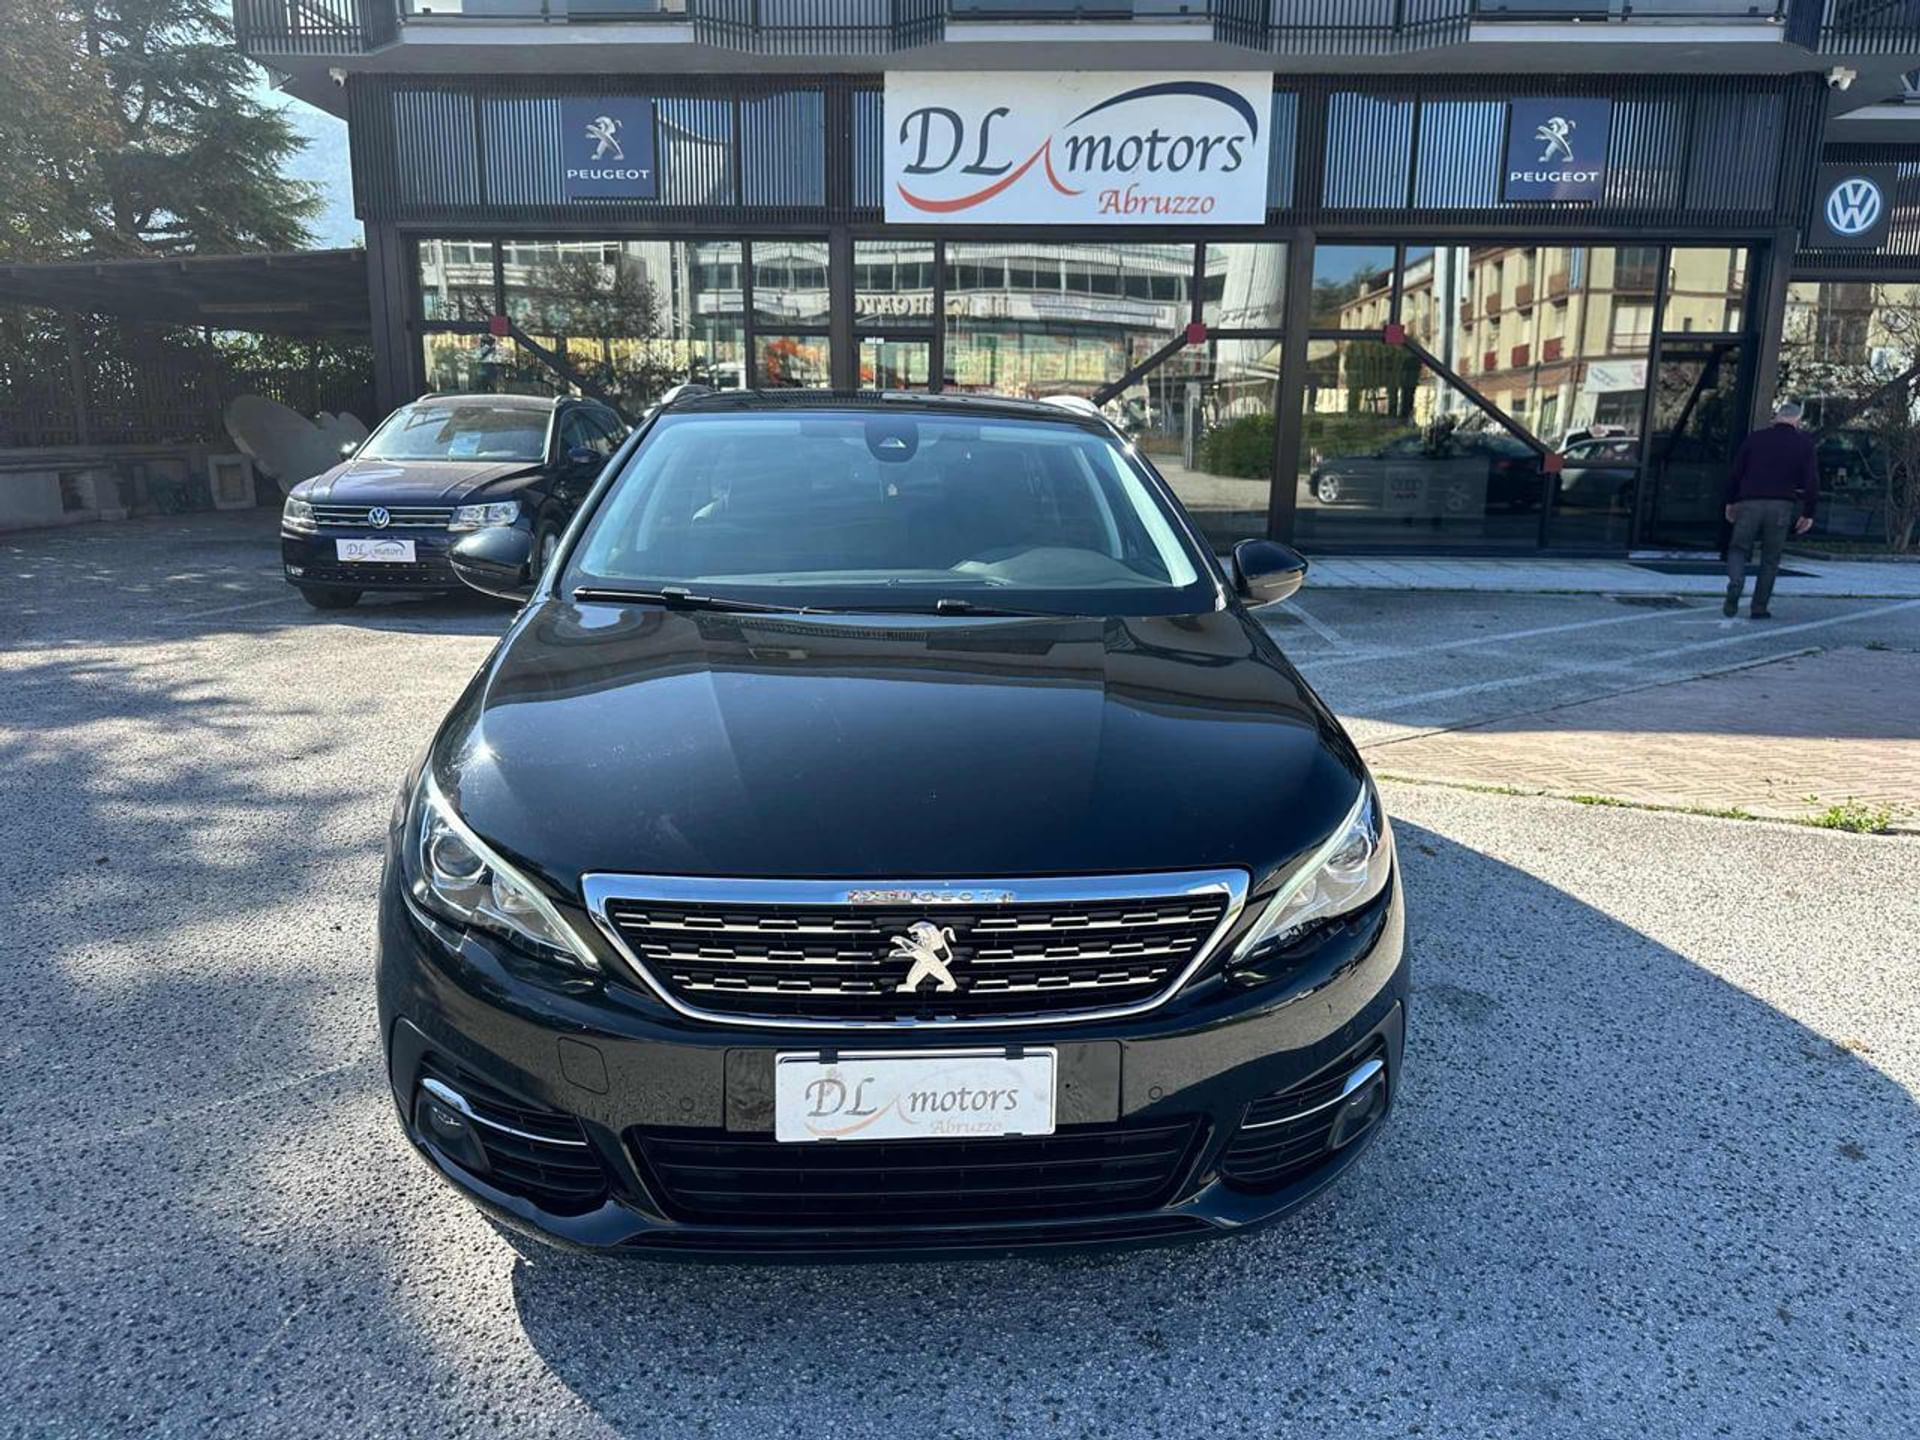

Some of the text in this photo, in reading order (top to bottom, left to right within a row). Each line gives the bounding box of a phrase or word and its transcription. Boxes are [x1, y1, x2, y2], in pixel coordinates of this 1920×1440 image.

[899, 106, 1245, 176] DL motors
[566, 168, 651, 180] PEUGEOT
[1510, 171, 1600, 182] PEUGEOT
[1099, 183, 1215, 216] Abruzzo
[804, 1077, 1019, 1118] DL motors
